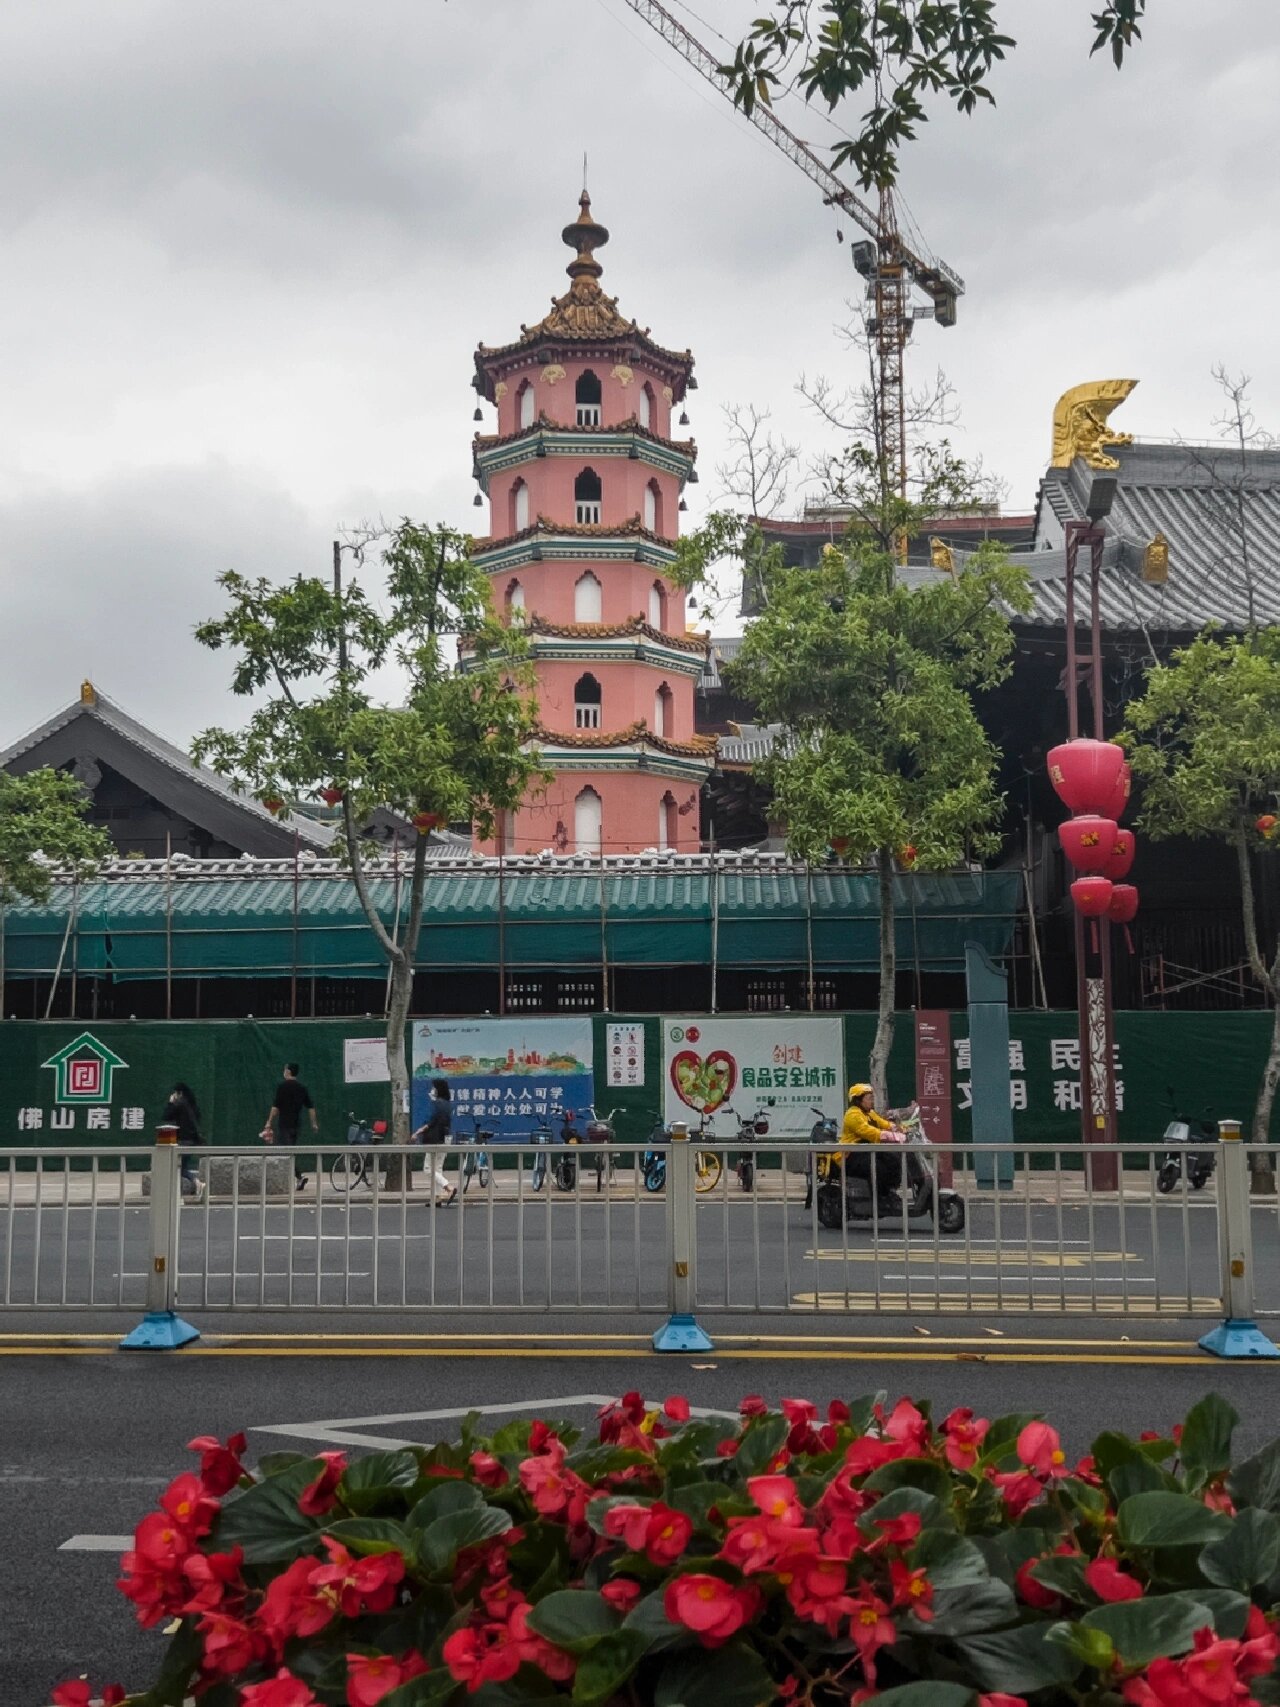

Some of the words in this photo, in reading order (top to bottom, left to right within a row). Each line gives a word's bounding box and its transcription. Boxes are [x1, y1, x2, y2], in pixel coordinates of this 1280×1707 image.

[773, 1044, 805, 1064] 创建
[742, 1067, 836, 1088] 食品安全城市
[17, 1107, 145, 1130] 佛山房建
